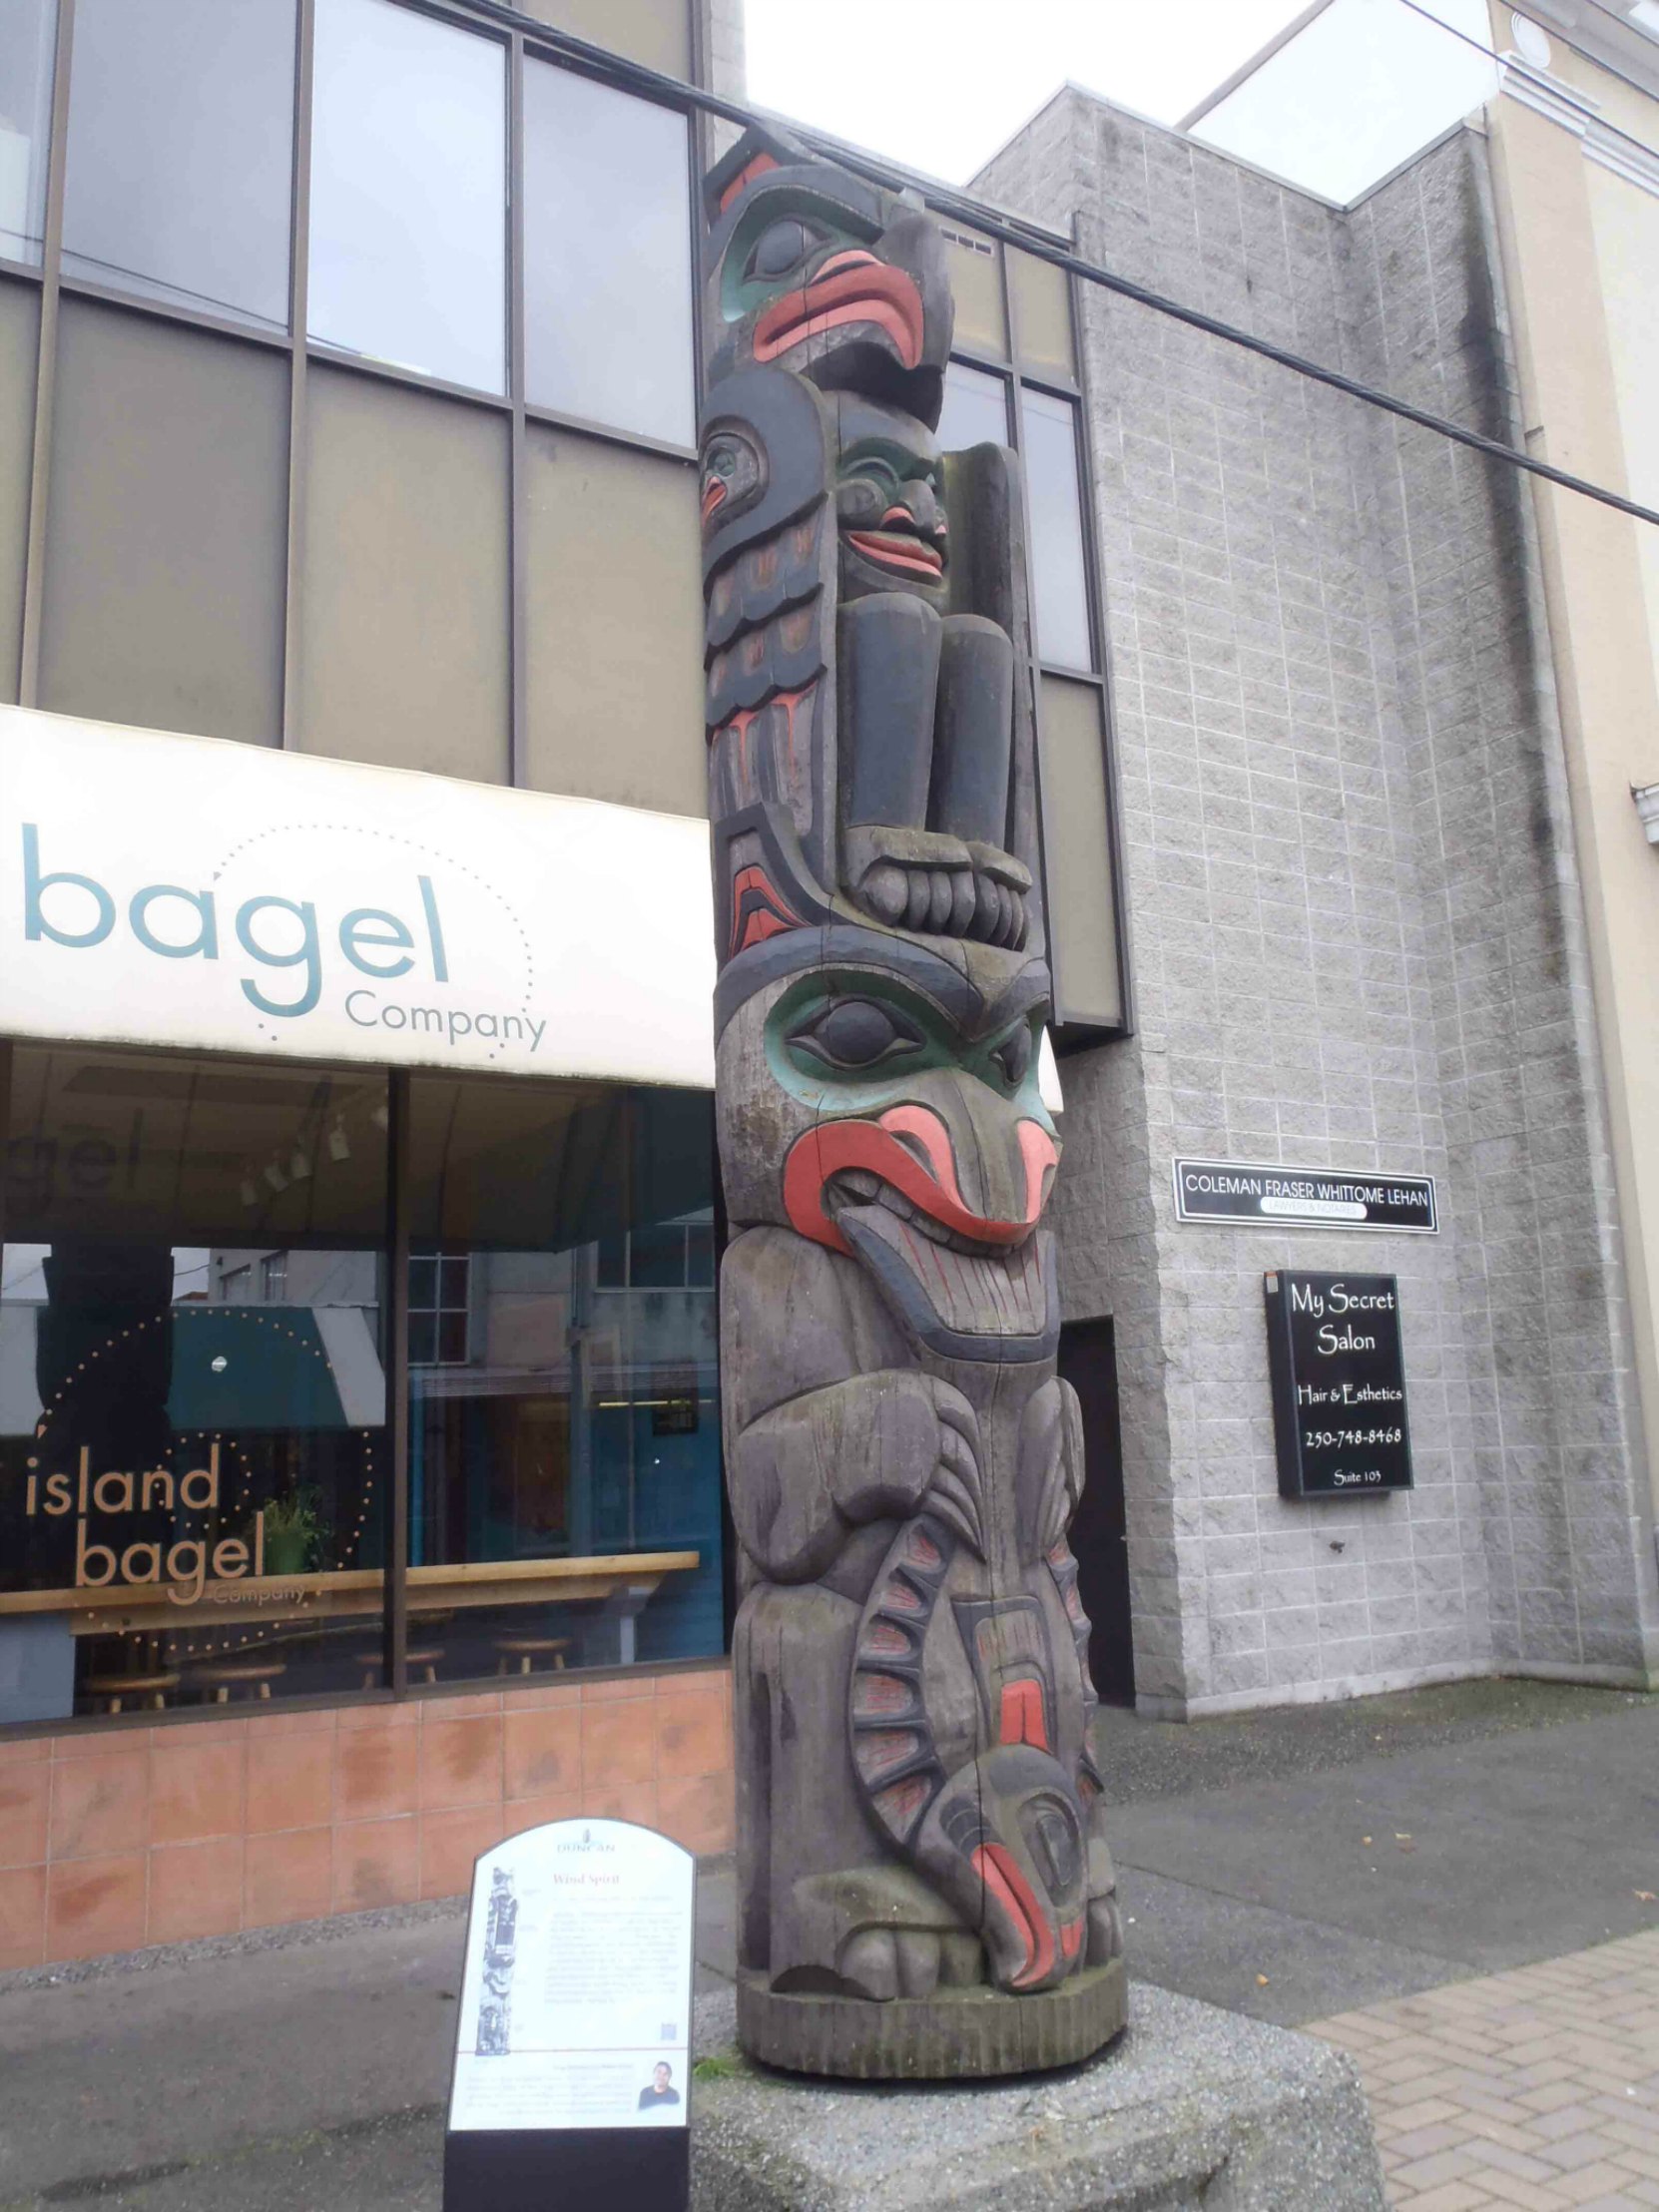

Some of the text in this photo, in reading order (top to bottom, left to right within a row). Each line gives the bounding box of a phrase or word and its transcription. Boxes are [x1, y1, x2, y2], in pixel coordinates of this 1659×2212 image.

[22, 823, 449, 1018] bagel
[344, 989, 547, 1053] Company
[1185, 1174, 1428, 1207] COLEMAN FRASER WHITTOME LEHAN
[1291, 1283, 1395, 1318] My Secret
[1317, 1324, 1376, 1355] Salon
[1298, 1382, 1402, 1405] Hair & Esthetics
[1306, 1426, 1401, 1448] 250-748-8468
[26, 1442, 220, 1515] island
[1334, 1468, 1382, 1486] Suite 103
[75, 1510, 264, 1606] bagel
[212, 1583, 305, 1606] Company
[553, 1873, 585, 1886] Wind
